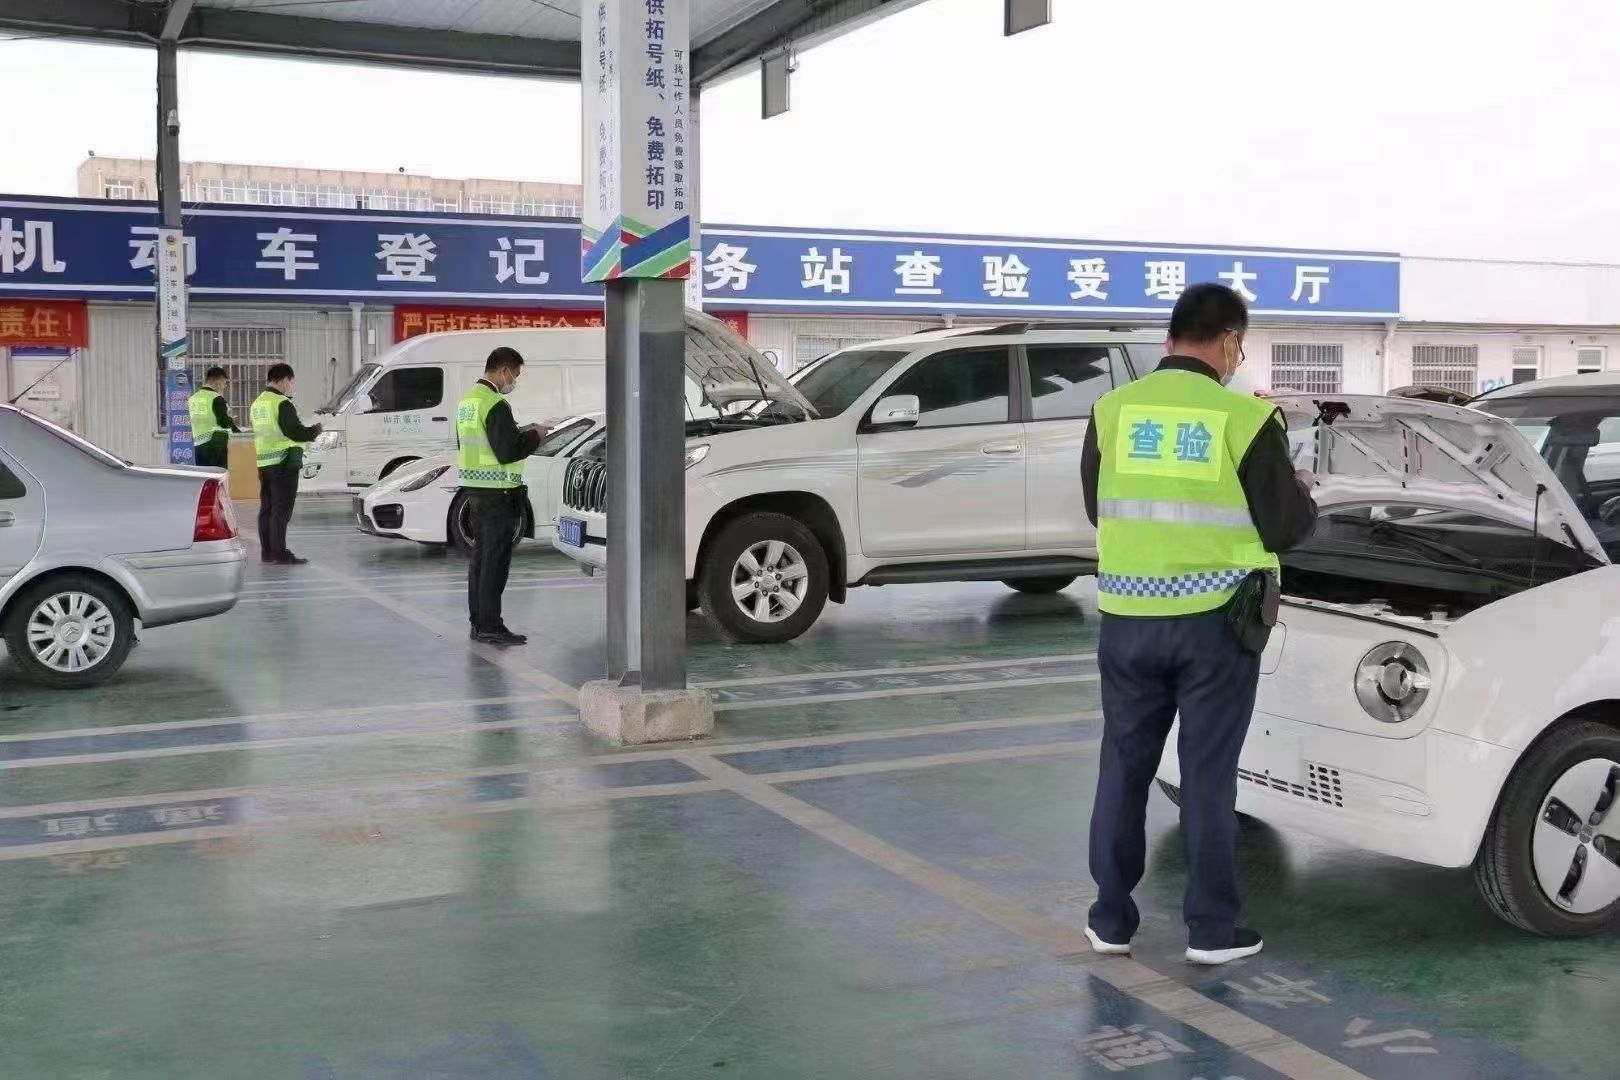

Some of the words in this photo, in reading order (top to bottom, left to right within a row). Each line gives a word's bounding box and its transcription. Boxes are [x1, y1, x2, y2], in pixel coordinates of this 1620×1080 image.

[0, 217, 1330, 304] 机动车登记务站查验受理大厅
[1128, 418, 1213, 463] 查验
